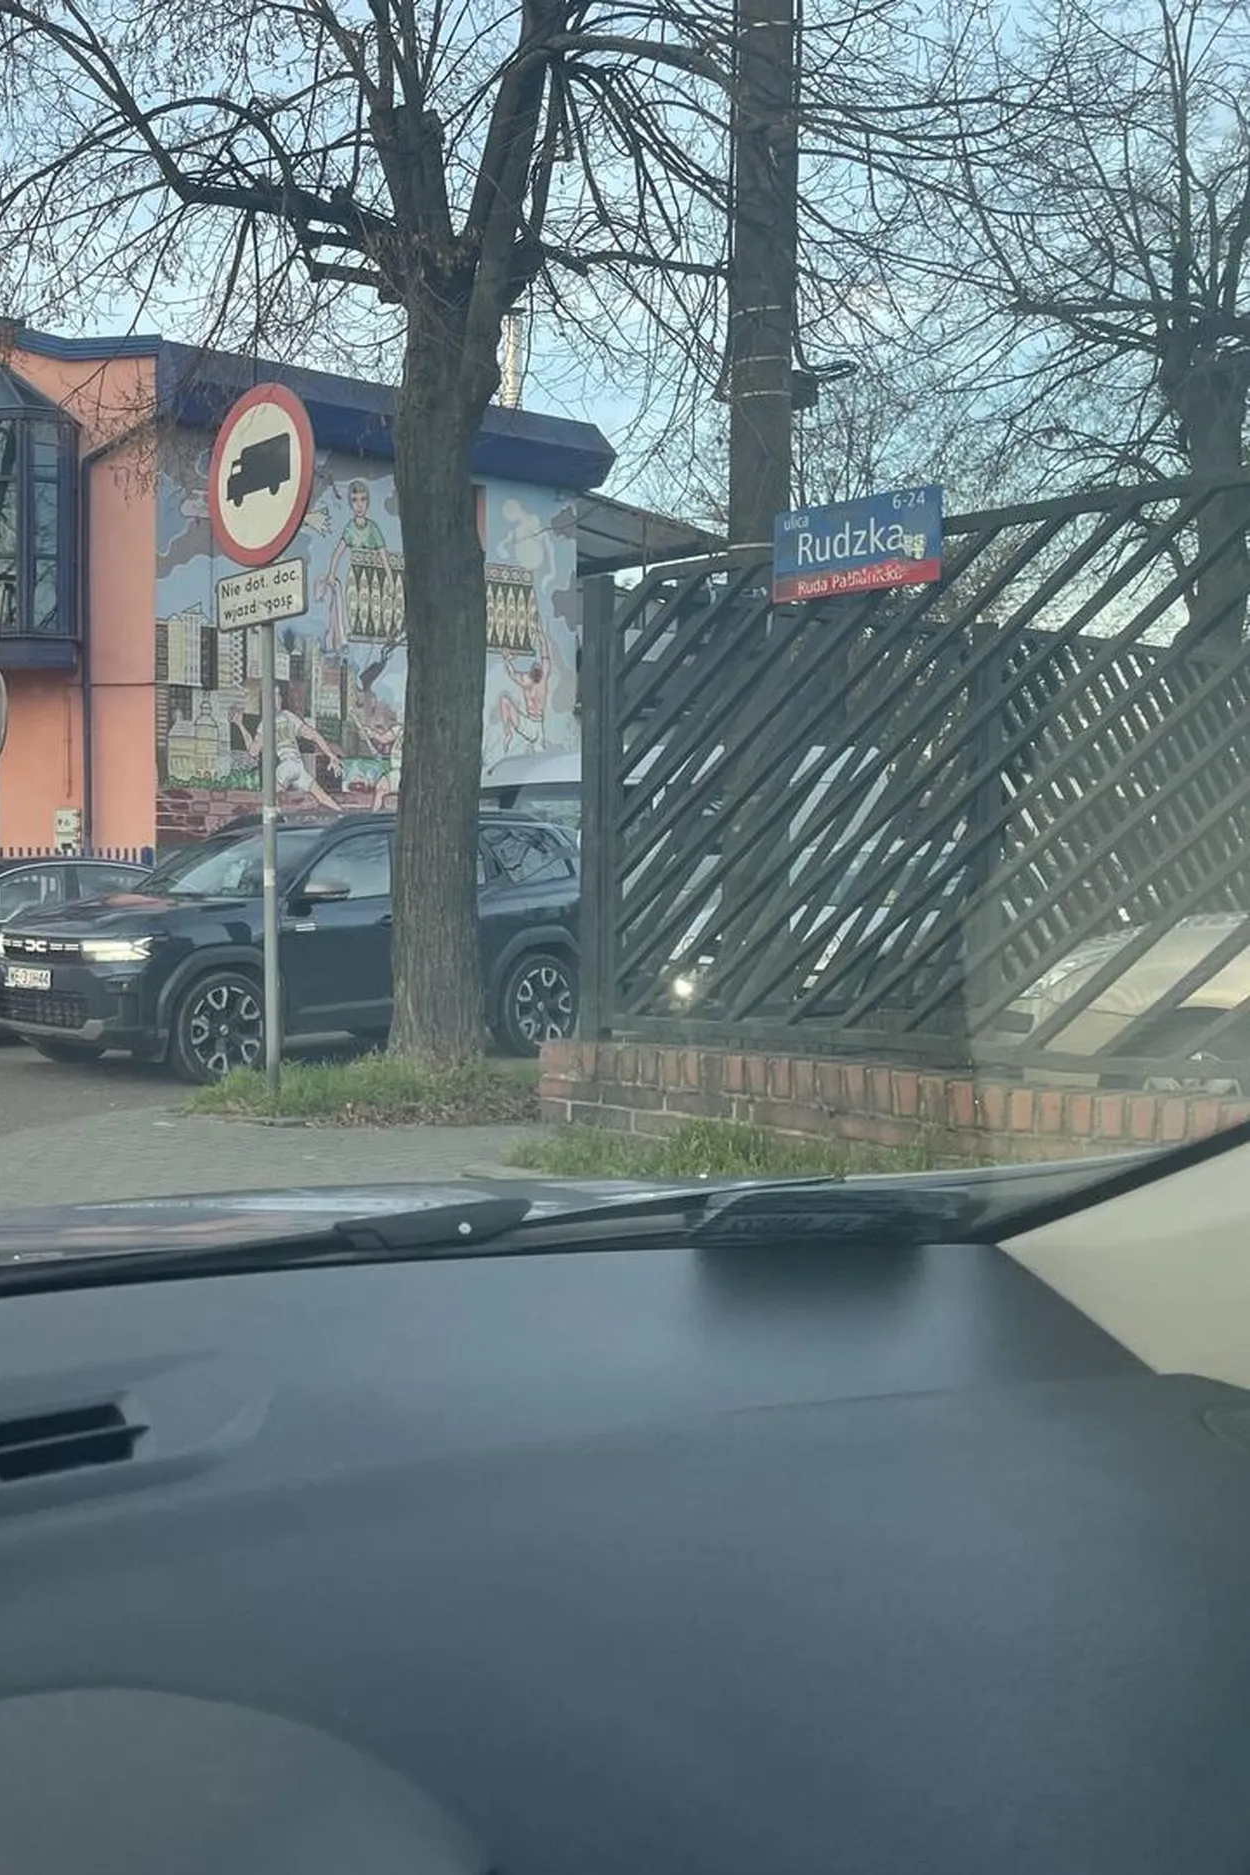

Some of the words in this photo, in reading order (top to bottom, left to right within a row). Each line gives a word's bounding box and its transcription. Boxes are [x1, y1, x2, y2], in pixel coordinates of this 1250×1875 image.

[892, 491, 925, 510] 6-24
[783, 514, 809, 531] ulica
[797, 517, 907, 566] Rudzka
[221, 583, 242, 599] Nie
